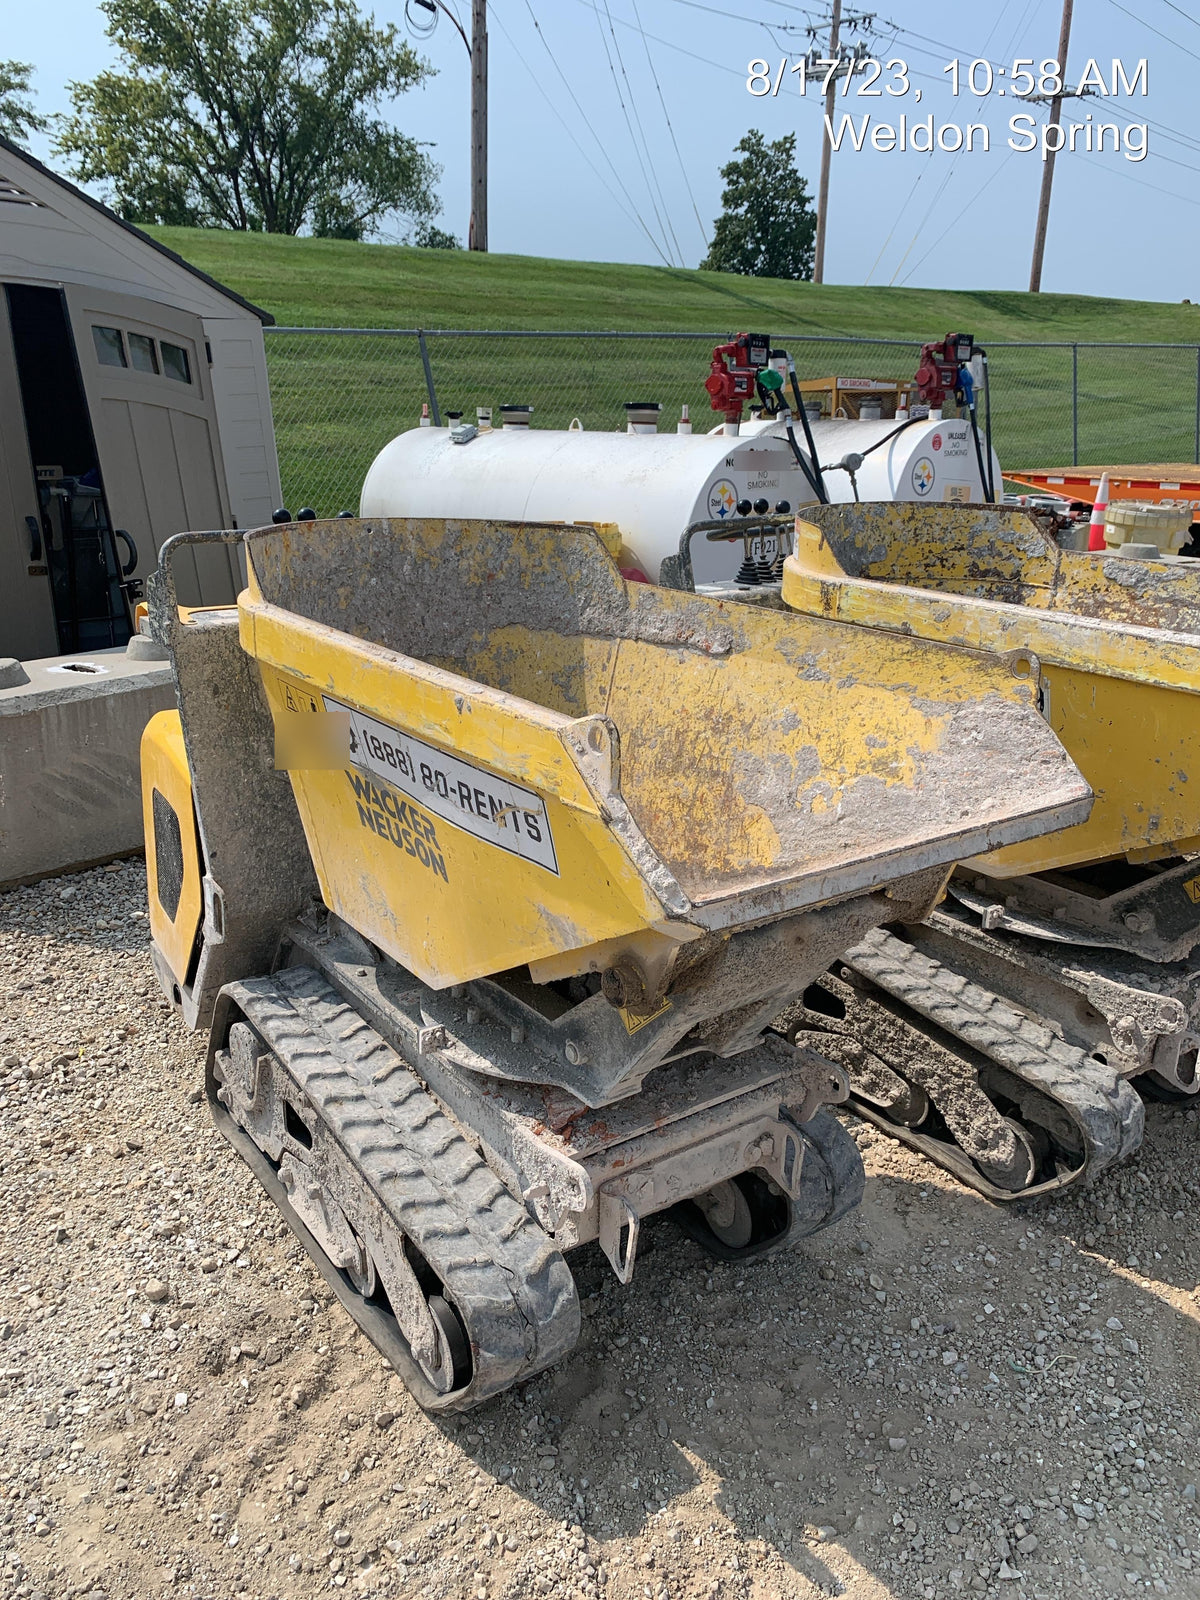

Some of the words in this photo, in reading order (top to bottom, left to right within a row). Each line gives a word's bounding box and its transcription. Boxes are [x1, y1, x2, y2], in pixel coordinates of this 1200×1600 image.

[757, 471, 768, 479] NO
[344, 769, 442, 852] WACKER
[363, 729, 416, 783] (888)
[420, 762, 542, 843] 80-RENTS
[356, 800, 449, 884] NEUSON
